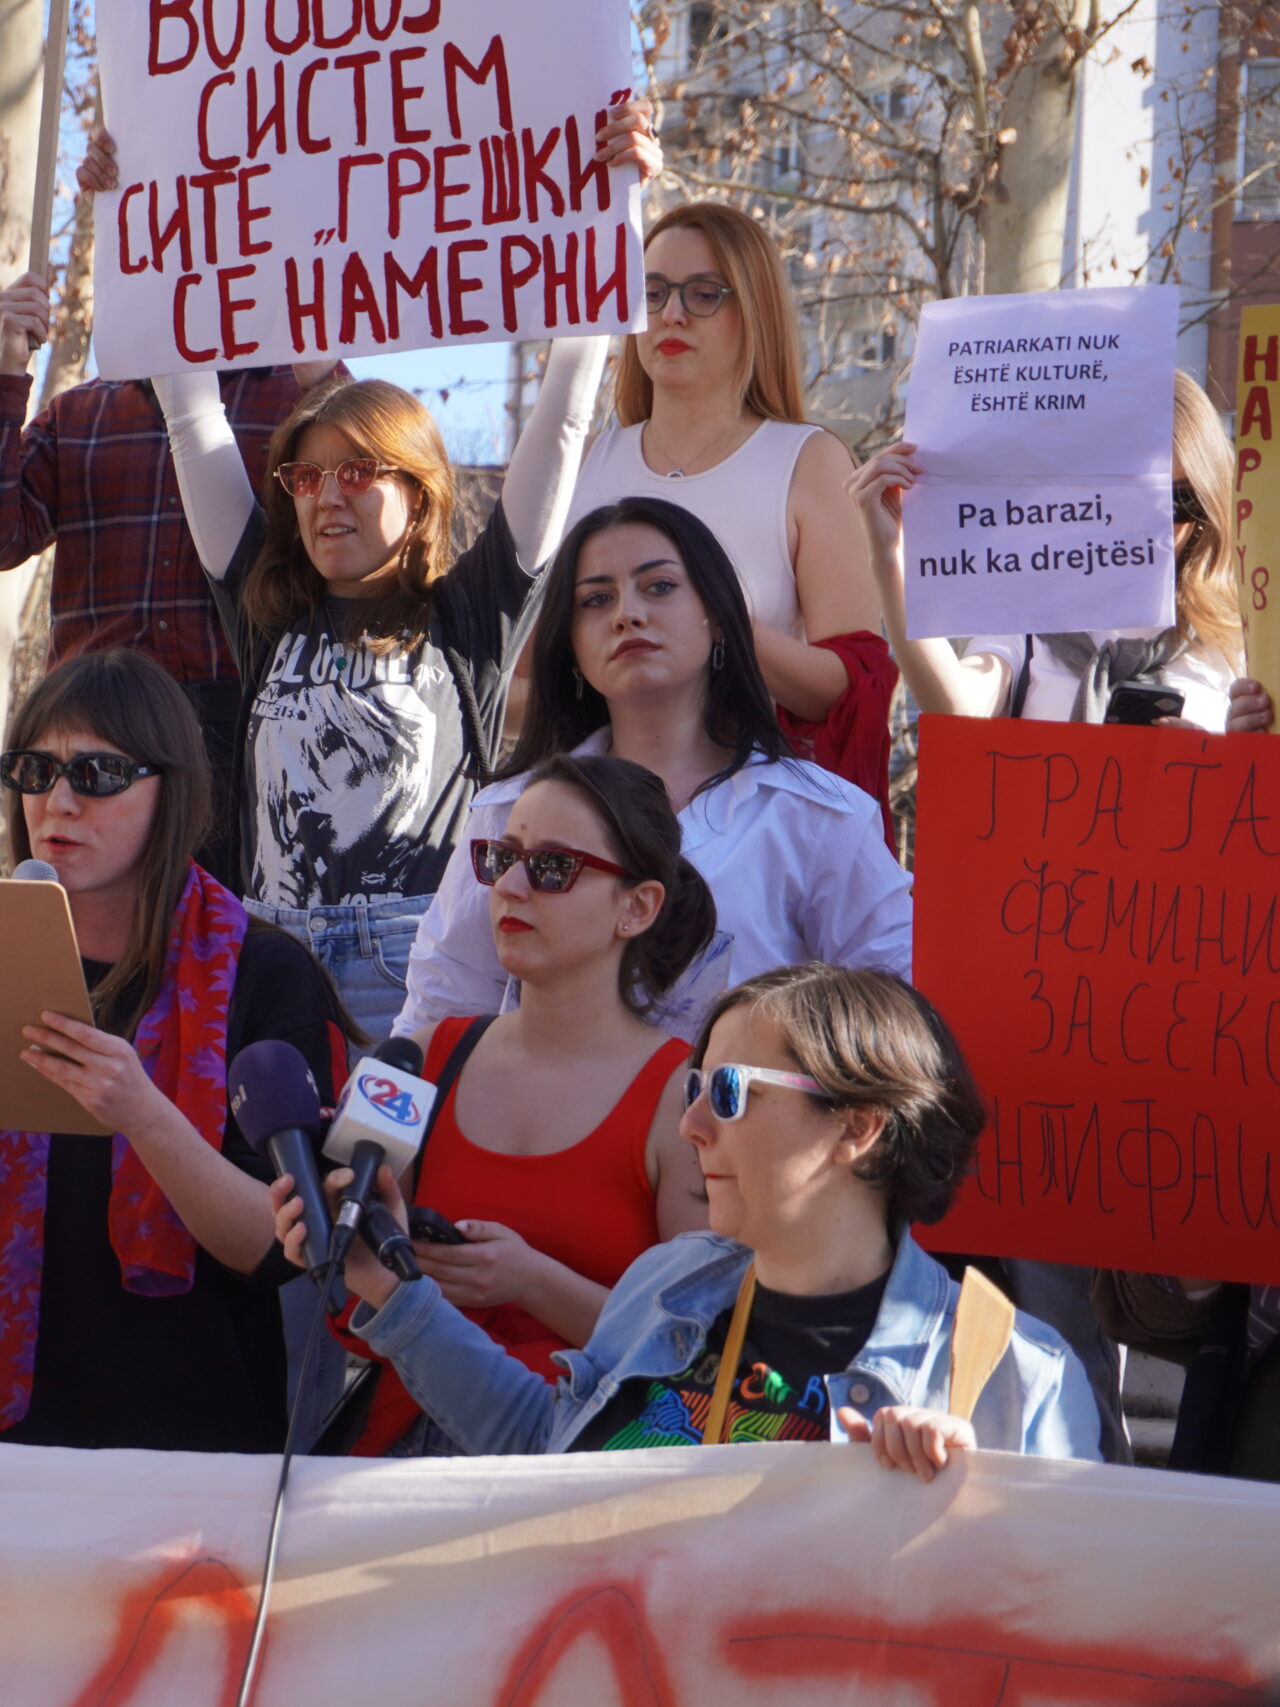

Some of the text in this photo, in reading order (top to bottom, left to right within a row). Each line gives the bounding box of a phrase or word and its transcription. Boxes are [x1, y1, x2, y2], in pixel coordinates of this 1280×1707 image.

[197, 34, 514, 171] СИСТЕМ
[118, 163, 272, 275] СИТЕ
[173, 222, 632, 364] СЕ НАМЕРНИ
[948, 334, 1120, 357] PATRIARKATI NUK
[953, 362, 1109, 384] ËSHTË KULTURË,
[971, 392, 1086, 412] ËSHTË KRIM
[958, 494, 1113, 529] Pa barazi,
[920, 538, 1155, 577] nuk ka drejtësi
[368, 1077, 413, 1122] 24
